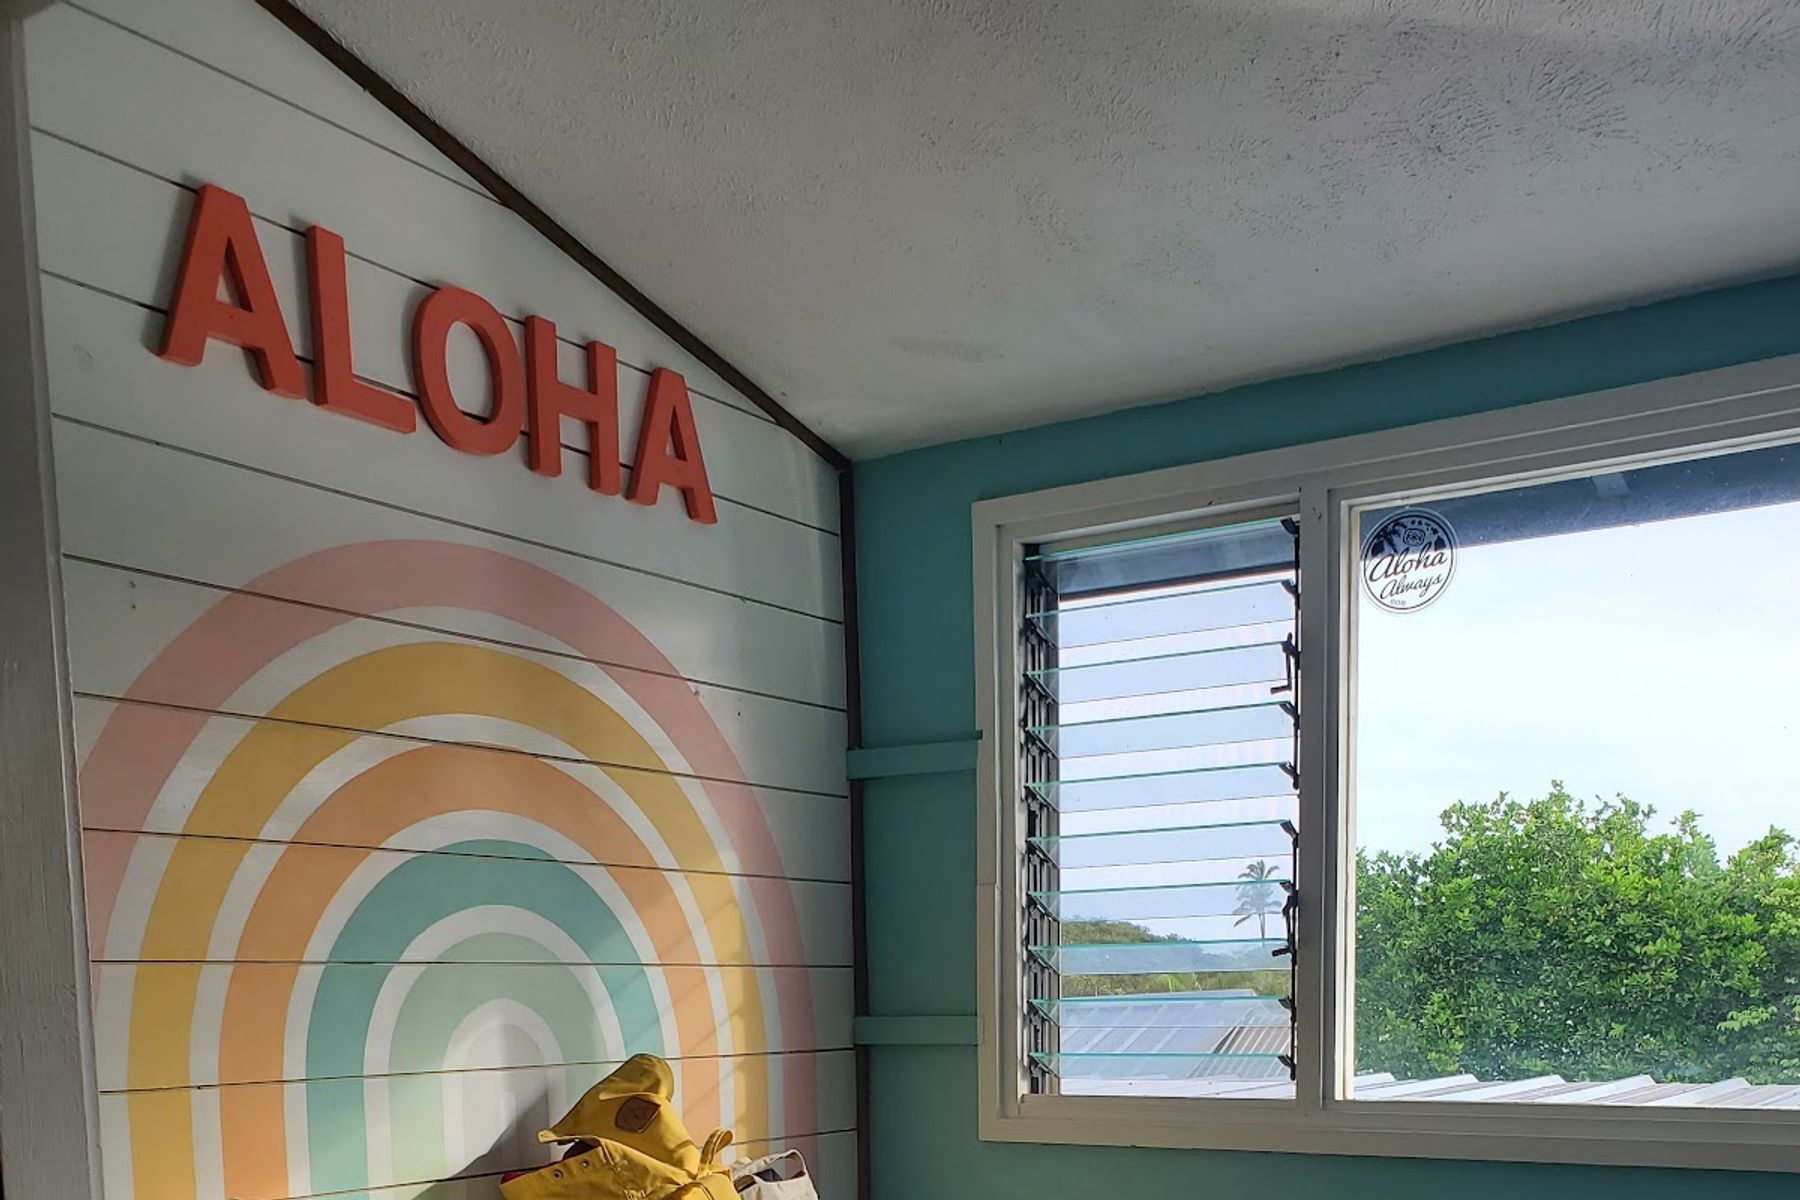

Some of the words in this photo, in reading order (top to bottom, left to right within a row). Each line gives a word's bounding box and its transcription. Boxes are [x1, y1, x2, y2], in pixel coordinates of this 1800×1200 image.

[156, 182, 718, 525] ALOHA
[1369, 541, 1448, 582] Aloha
[1380, 574, 1443, 600] Always
